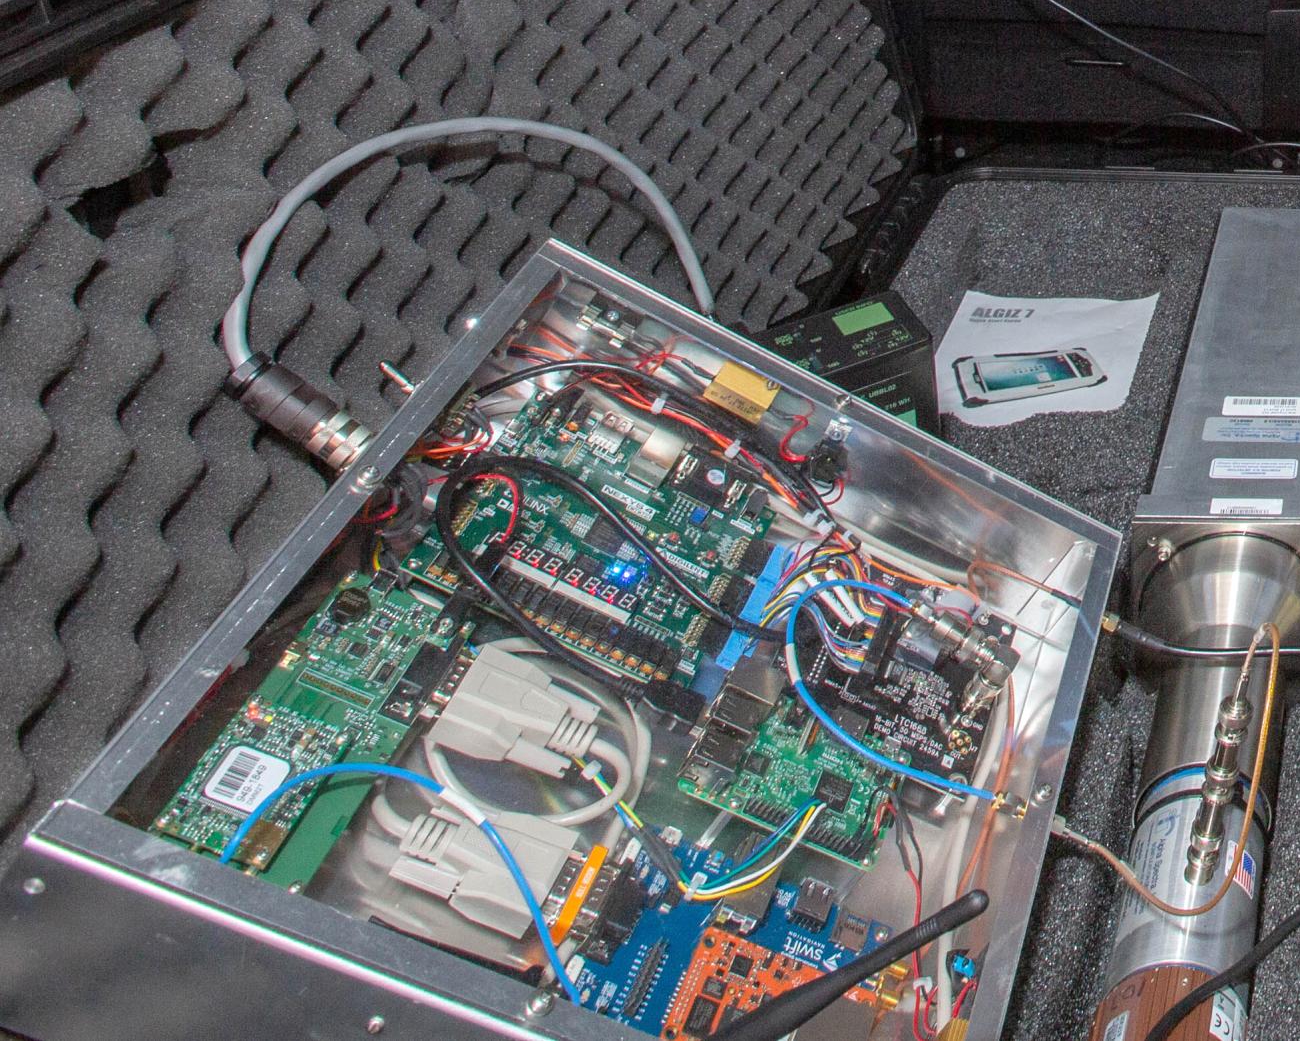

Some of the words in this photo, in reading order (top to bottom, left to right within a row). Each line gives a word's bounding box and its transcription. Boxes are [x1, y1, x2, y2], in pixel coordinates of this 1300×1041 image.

[971, 307, 1022, 319] ALGIZ
[1024, 309, 1036, 318] 7
[523, 494, 550, 516] ILINX
[873, 723, 890, 734] DEMO
[784, 936, 824, 961] swift
[788, 931, 826, 949] NAVIGATION
